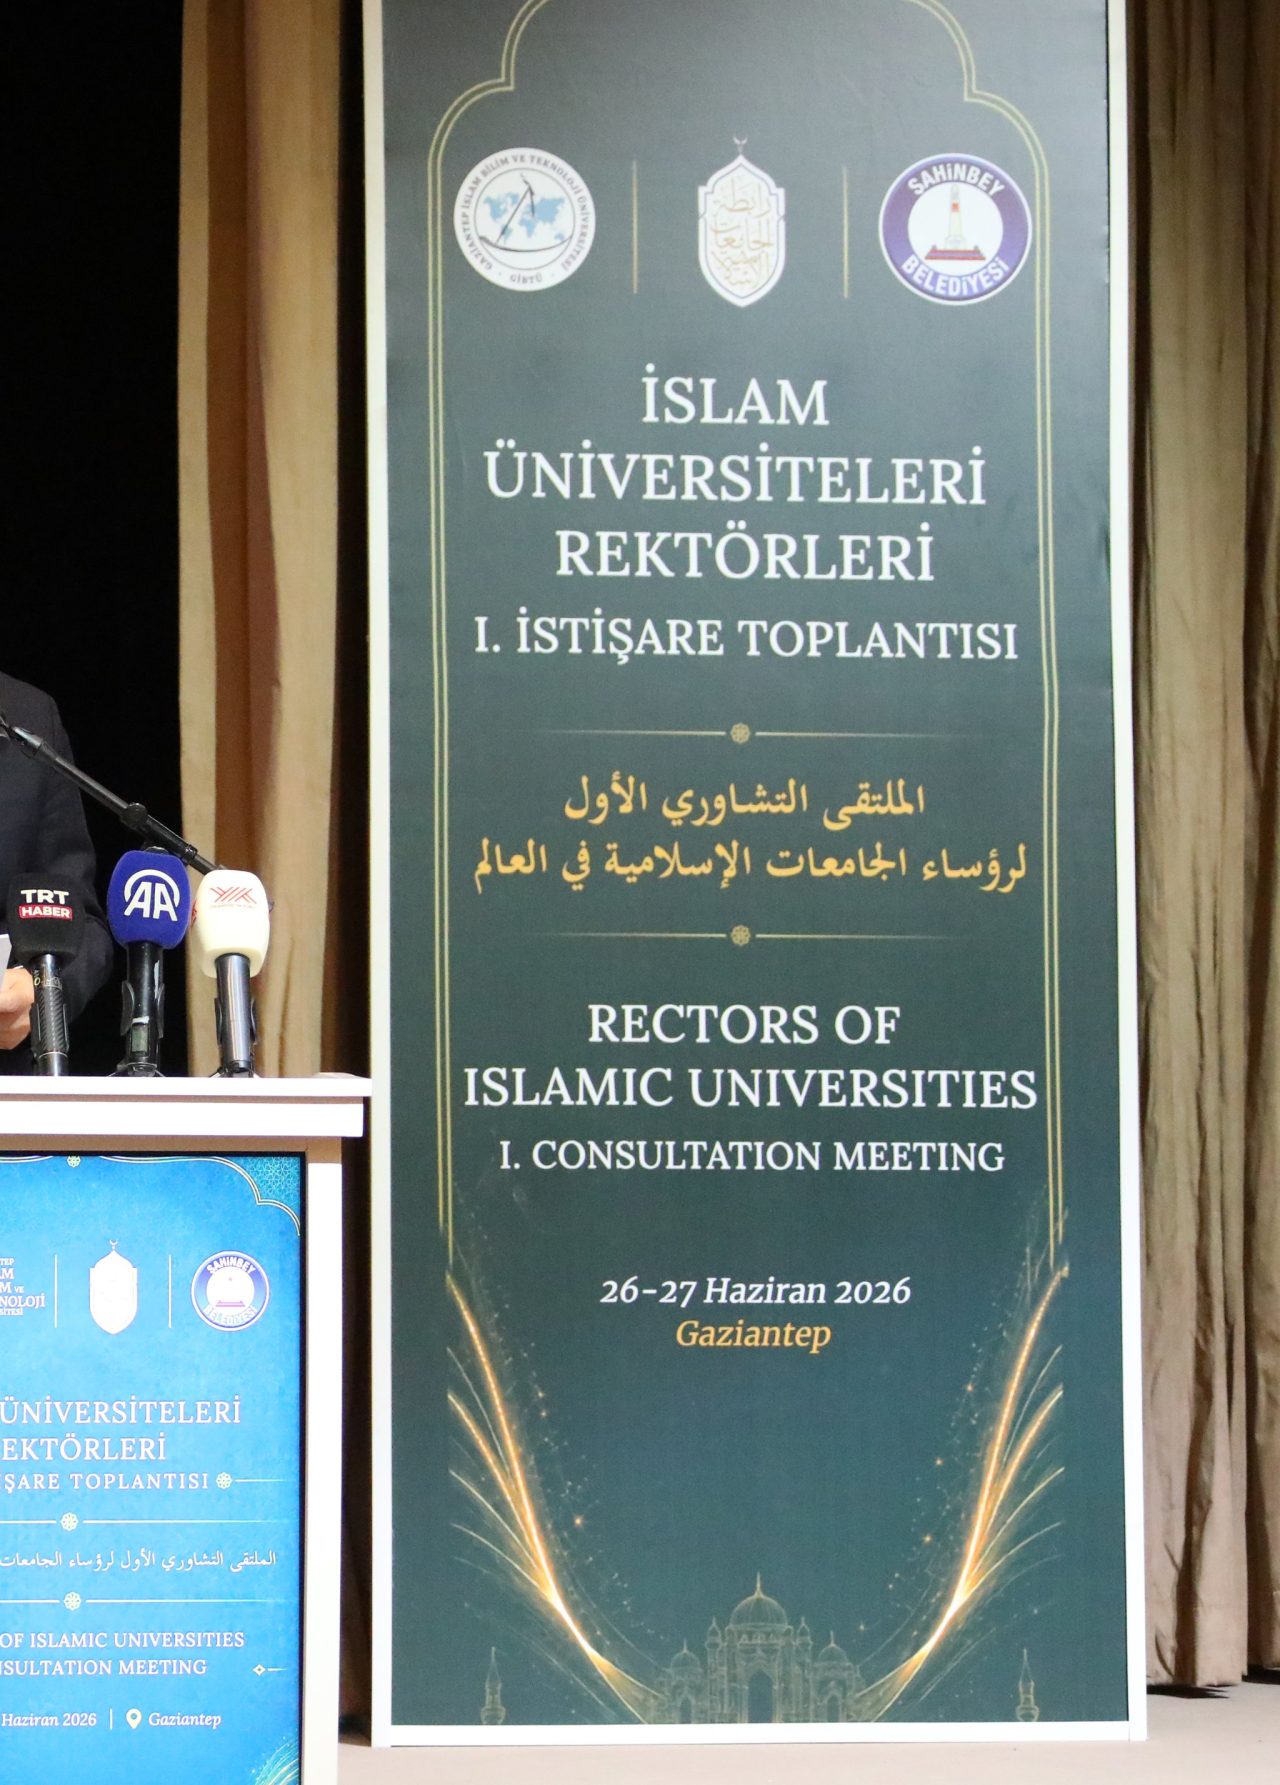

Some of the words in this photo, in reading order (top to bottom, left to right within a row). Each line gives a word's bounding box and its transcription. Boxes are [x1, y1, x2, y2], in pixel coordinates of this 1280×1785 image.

[460, 175, 483, 210] İSLAM
[480, 156, 510, 179] BİLİM
[511, 154, 526, 163] VE
[642, 363, 829, 425] İSLAM
[484, 439, 986, 504] ÜNİVERSİTELERİ
[556, 520, 934, 581] REKTÖRLERİ
[475, 616, 500, 652] I.
[517, 606, 724, 665] İSTİŞARE
[738, 620, 1018, 659] TOPLANTISI
[565, 771, 647, 825] الأول
[662, 778, 807, 826] التشاوري
[823, 779, 924, 831] الملتقى
[475, 838, 547, 893] العالم
[562, 840, 590, 891] في
[605, 840, 750, 888] الإسلامية
[767, 842, 906, 880] الجامعات
[923, 843, 1026, 893] لرؤساء
[21, 889, 69, 904] TRT
[22, 906, 70, 918] HABER
[124, 880, 179, 922] AA
[588, 1004, 818, 1044] RECTORS
[835, 1005, 900, 1044] OF
[464, 1067, 672, 1106] ISLAMIC
[688, 1069, 1037, 1109] UNIVERSITIES
[500, 1141, 520, 1169] I.
[533, 1140, 821, 1170] CONSULTATION
[834, 1142, 1005, 1171] MEETING
[703, 1276, 826, 1304] Haziran
[834, 1277, 911, 1304] 2026
[677, 1319, 831, 1354] Gaziantep
[0, 1395, 240, 1424] ÜNİVERSİTELERİ
[70, 1473, 208, 1489] TOPLANTISI
[0, 1551, 62, 1568] الجامعات
[68, 1551, 114, 1571] لرؤساء
[121, 1548, 155, 1571] الأول
[162, 1551, 223, 1572] التشاوري
[230, 1550, 276, 1572] الملتقى
[0, 1633, 24, 1648] OF
[30, 1633, 107, 1648] ISLAMIC
[114, 1632, 244, 1648] UNIVERSITIES
[119, 1660, 207, 1675] MEETING
[2, 1713, 59, 1727] Haziran
[62, 1713, 97, 1726] 2026
[148, 1712, 221, 1729] Gaziantep
